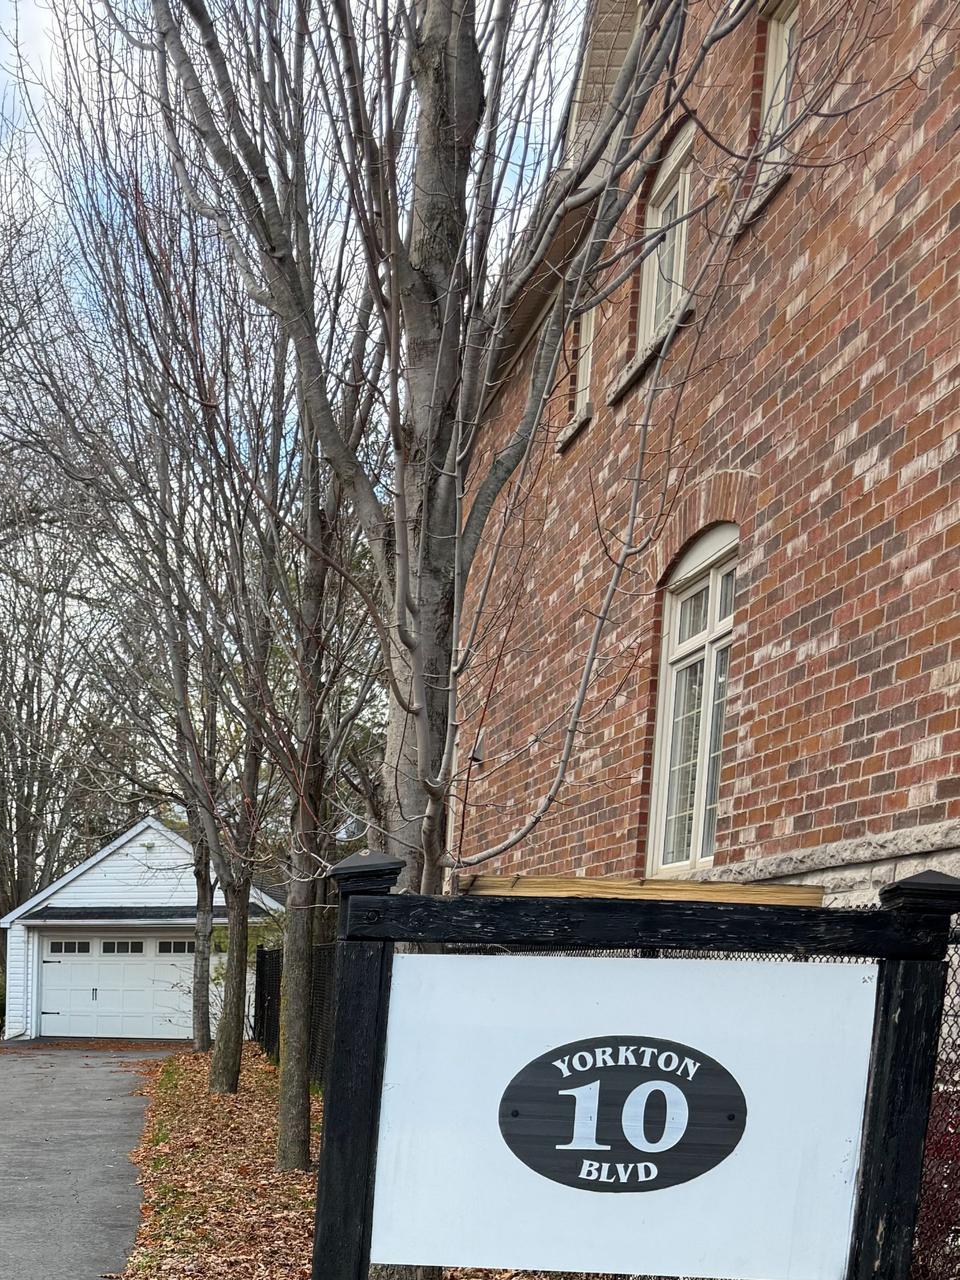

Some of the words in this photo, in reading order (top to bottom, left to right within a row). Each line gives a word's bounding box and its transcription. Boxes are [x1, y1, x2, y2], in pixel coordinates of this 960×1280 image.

[552, 1046, 701, 1081] YORKTON
[555, 1079, 689, 1153] 10
[578, 1159, 658, 1183] BLVD
